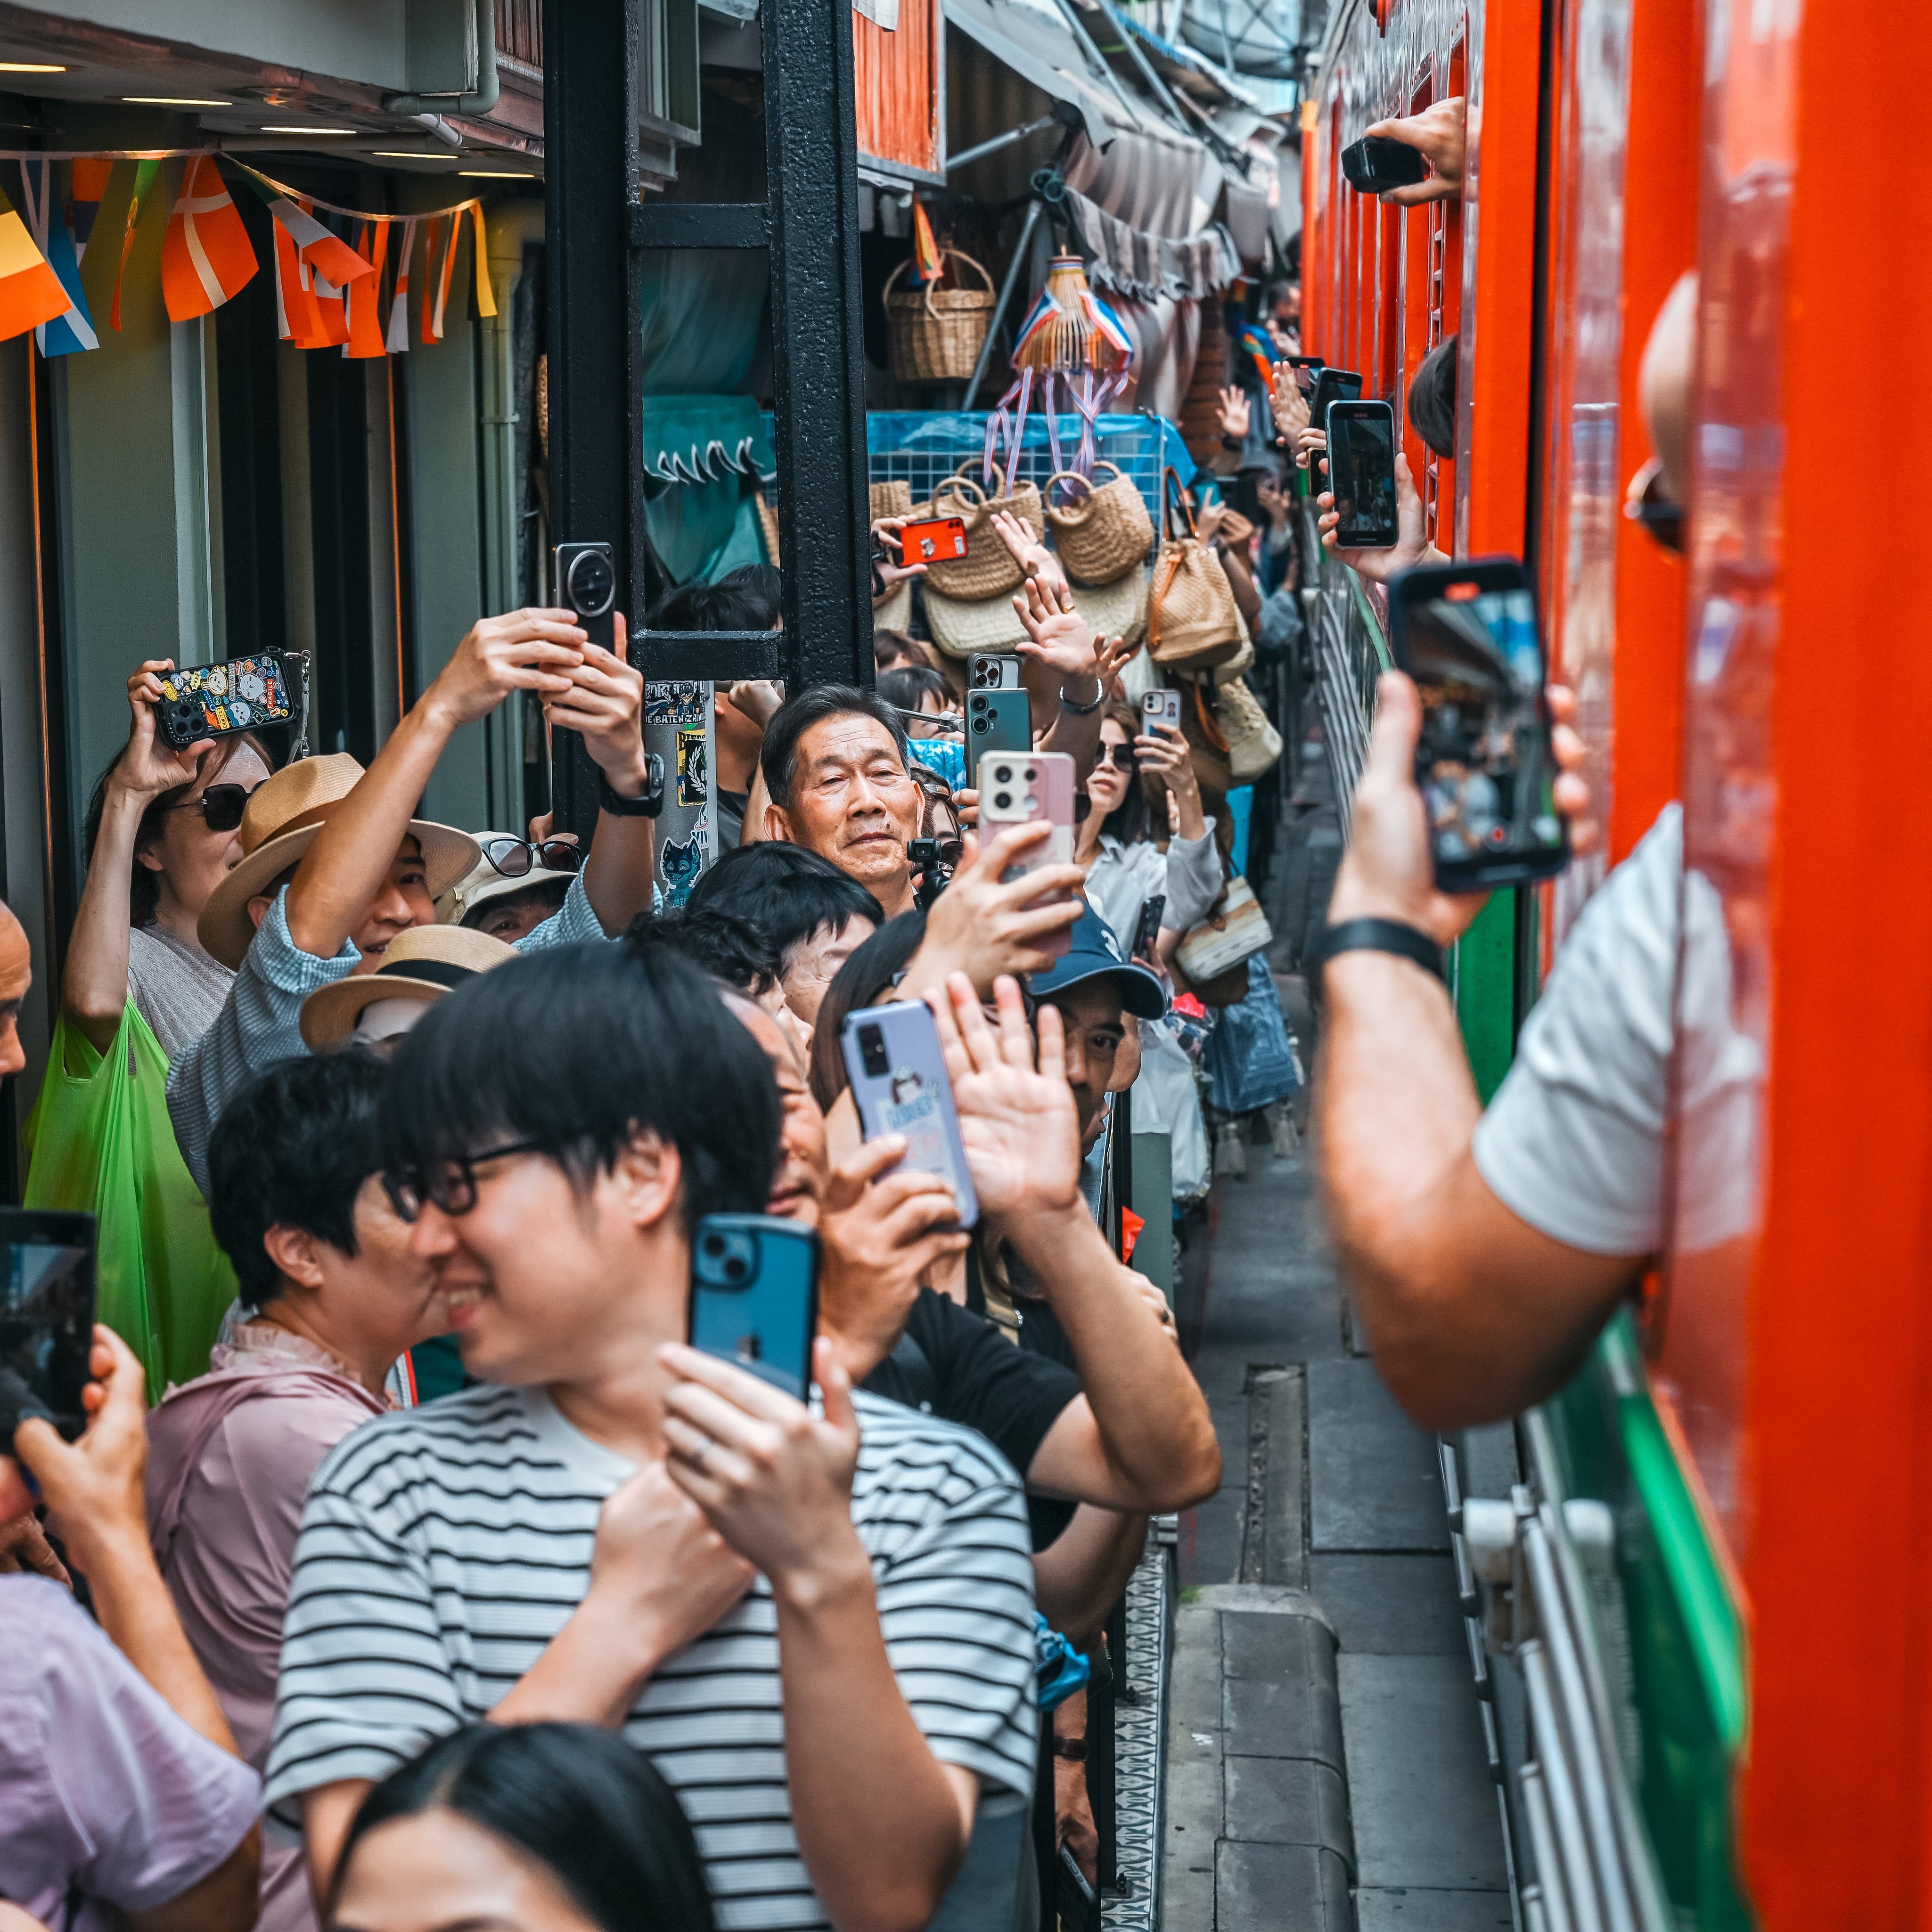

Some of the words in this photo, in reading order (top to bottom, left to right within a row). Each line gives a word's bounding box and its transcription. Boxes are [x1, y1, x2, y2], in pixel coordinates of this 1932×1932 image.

[228, 663, 236, 701] CHIIKAWA
[655, 715, 684, 723] BATEN
[692, 829, 709, 844] VIV
